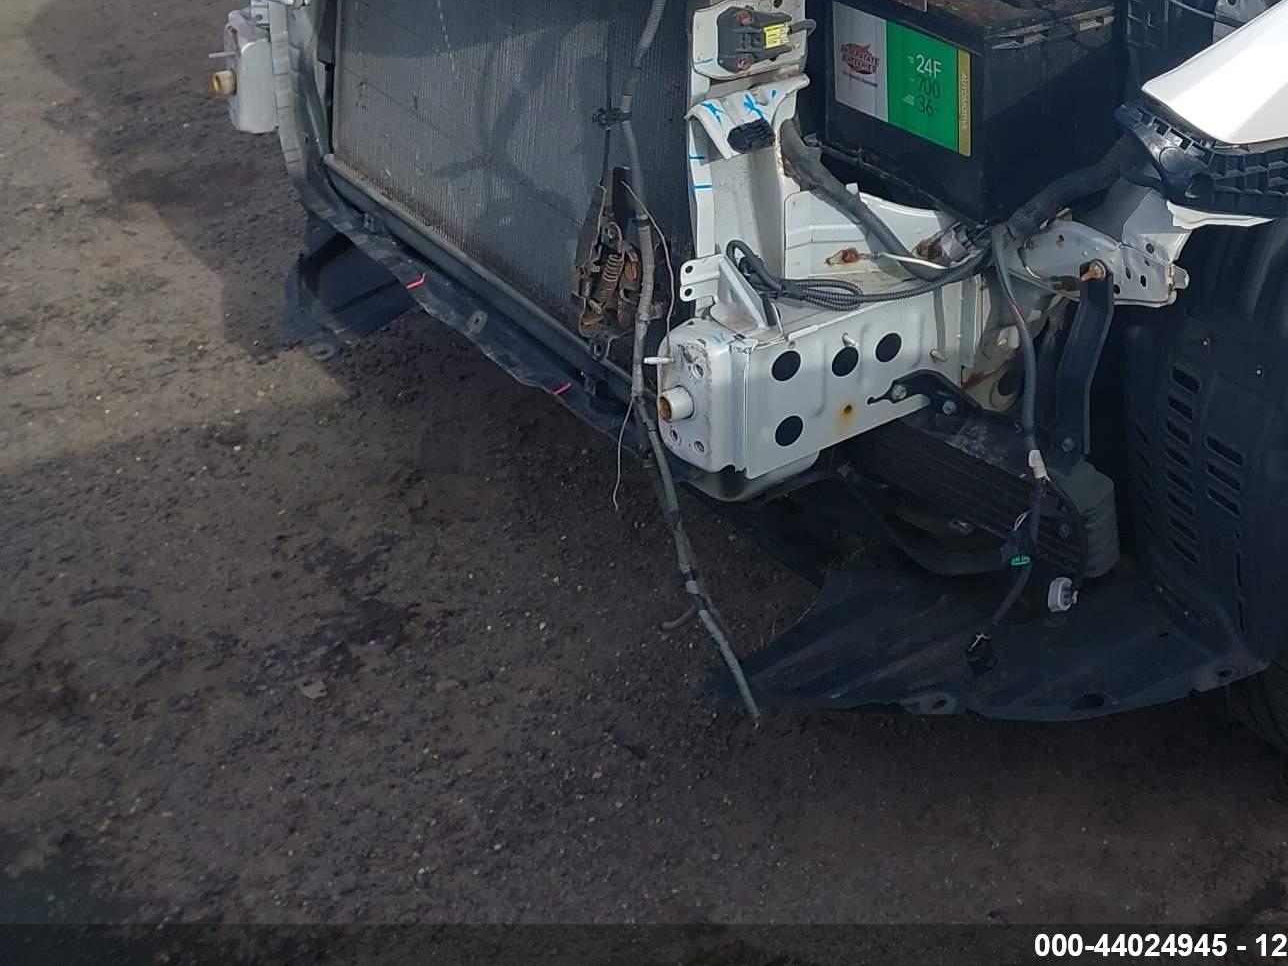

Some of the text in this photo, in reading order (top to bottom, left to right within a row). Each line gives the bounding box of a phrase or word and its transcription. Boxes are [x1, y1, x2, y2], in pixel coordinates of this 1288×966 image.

[916, 54, 942, 78] 24F
[918, 74, 940, 99] 700
[960, 72, 968, 130] AUTOMOTIVE
